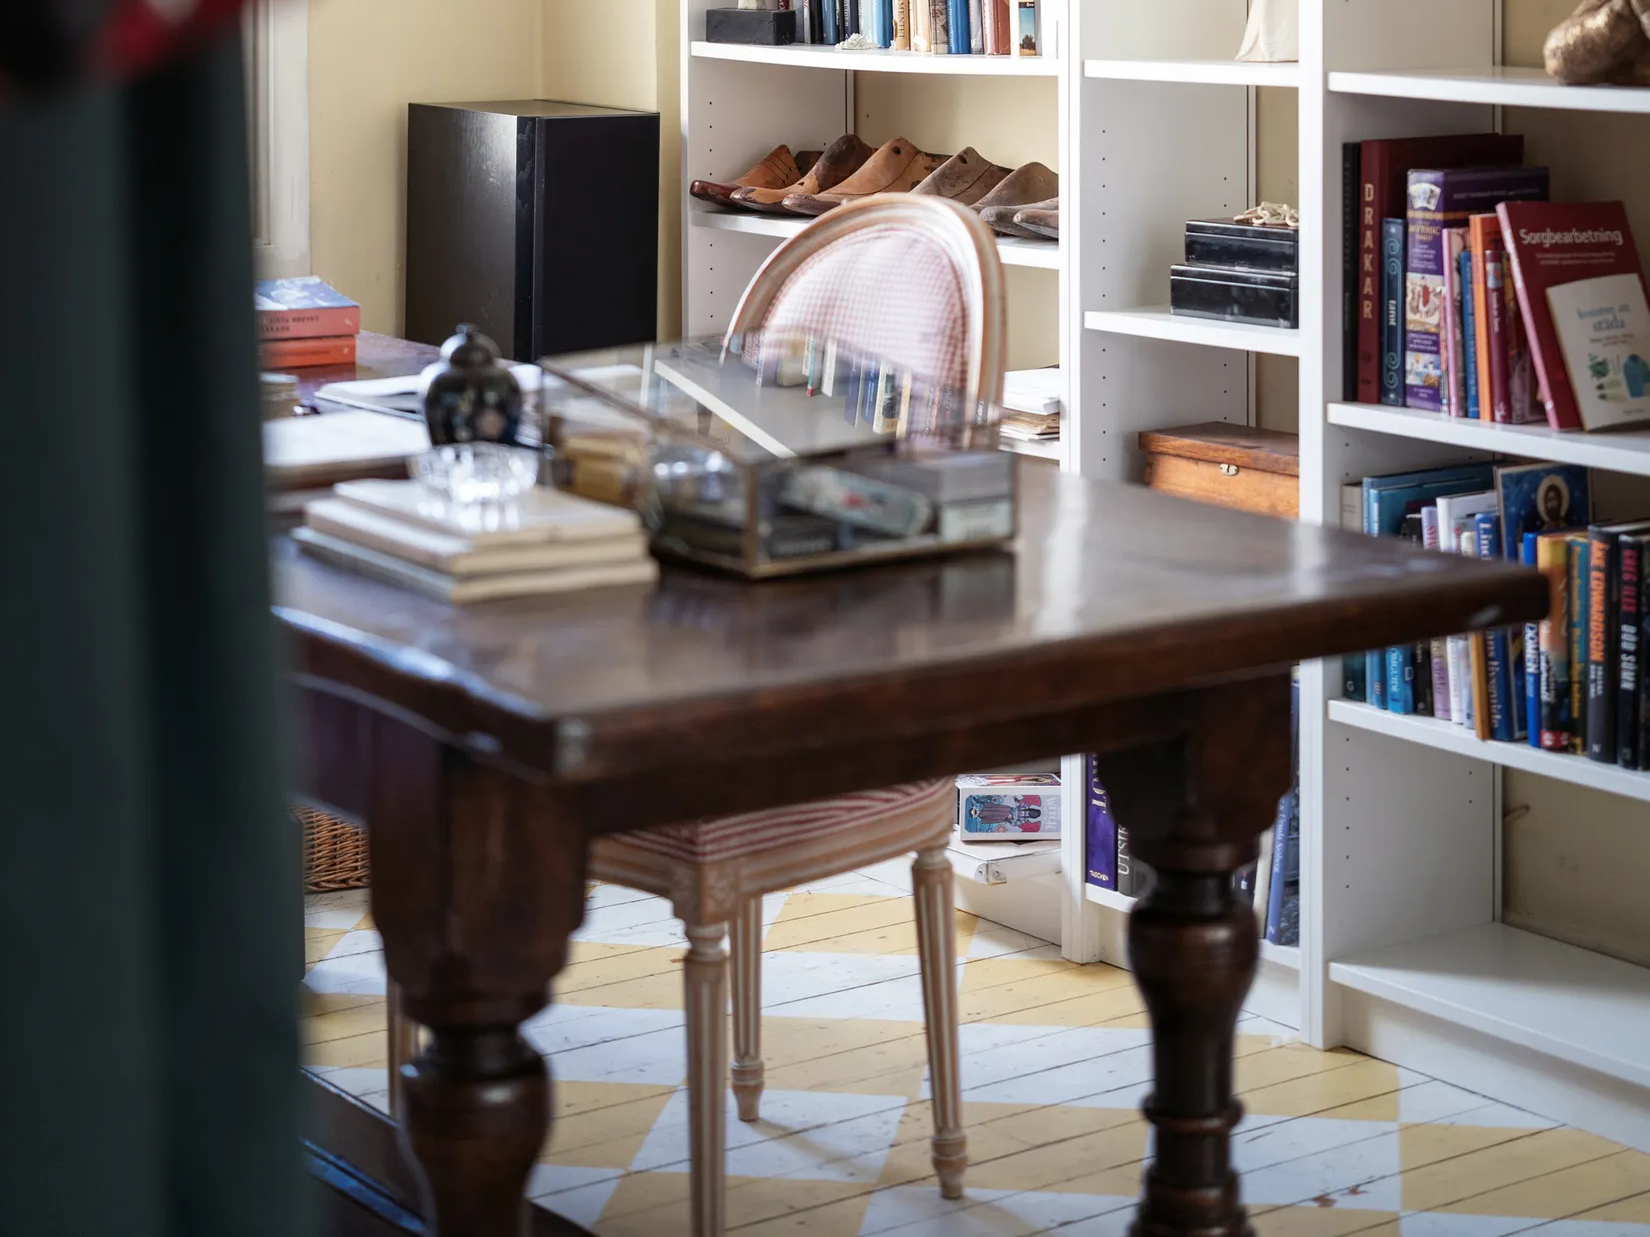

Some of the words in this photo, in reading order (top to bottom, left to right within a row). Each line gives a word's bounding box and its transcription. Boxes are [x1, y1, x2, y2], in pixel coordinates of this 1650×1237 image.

[1363, 183, 1374, 319] DRAKAR
[1519, 228, 1624, 248] Sorgbearbetning
[1388, 300, 1398, 326] tarot
[1591, 539, 1610, 567] ÅKE
[1622, 549, 1637, 584] GREG
[1622, 586, 1637, 612] ILES
[1590, 570, 1604, 662] EDWARDSON
[1620, 624, 1638, 652] DÖD
[1620, 653, 1638, 691] SÖMN
